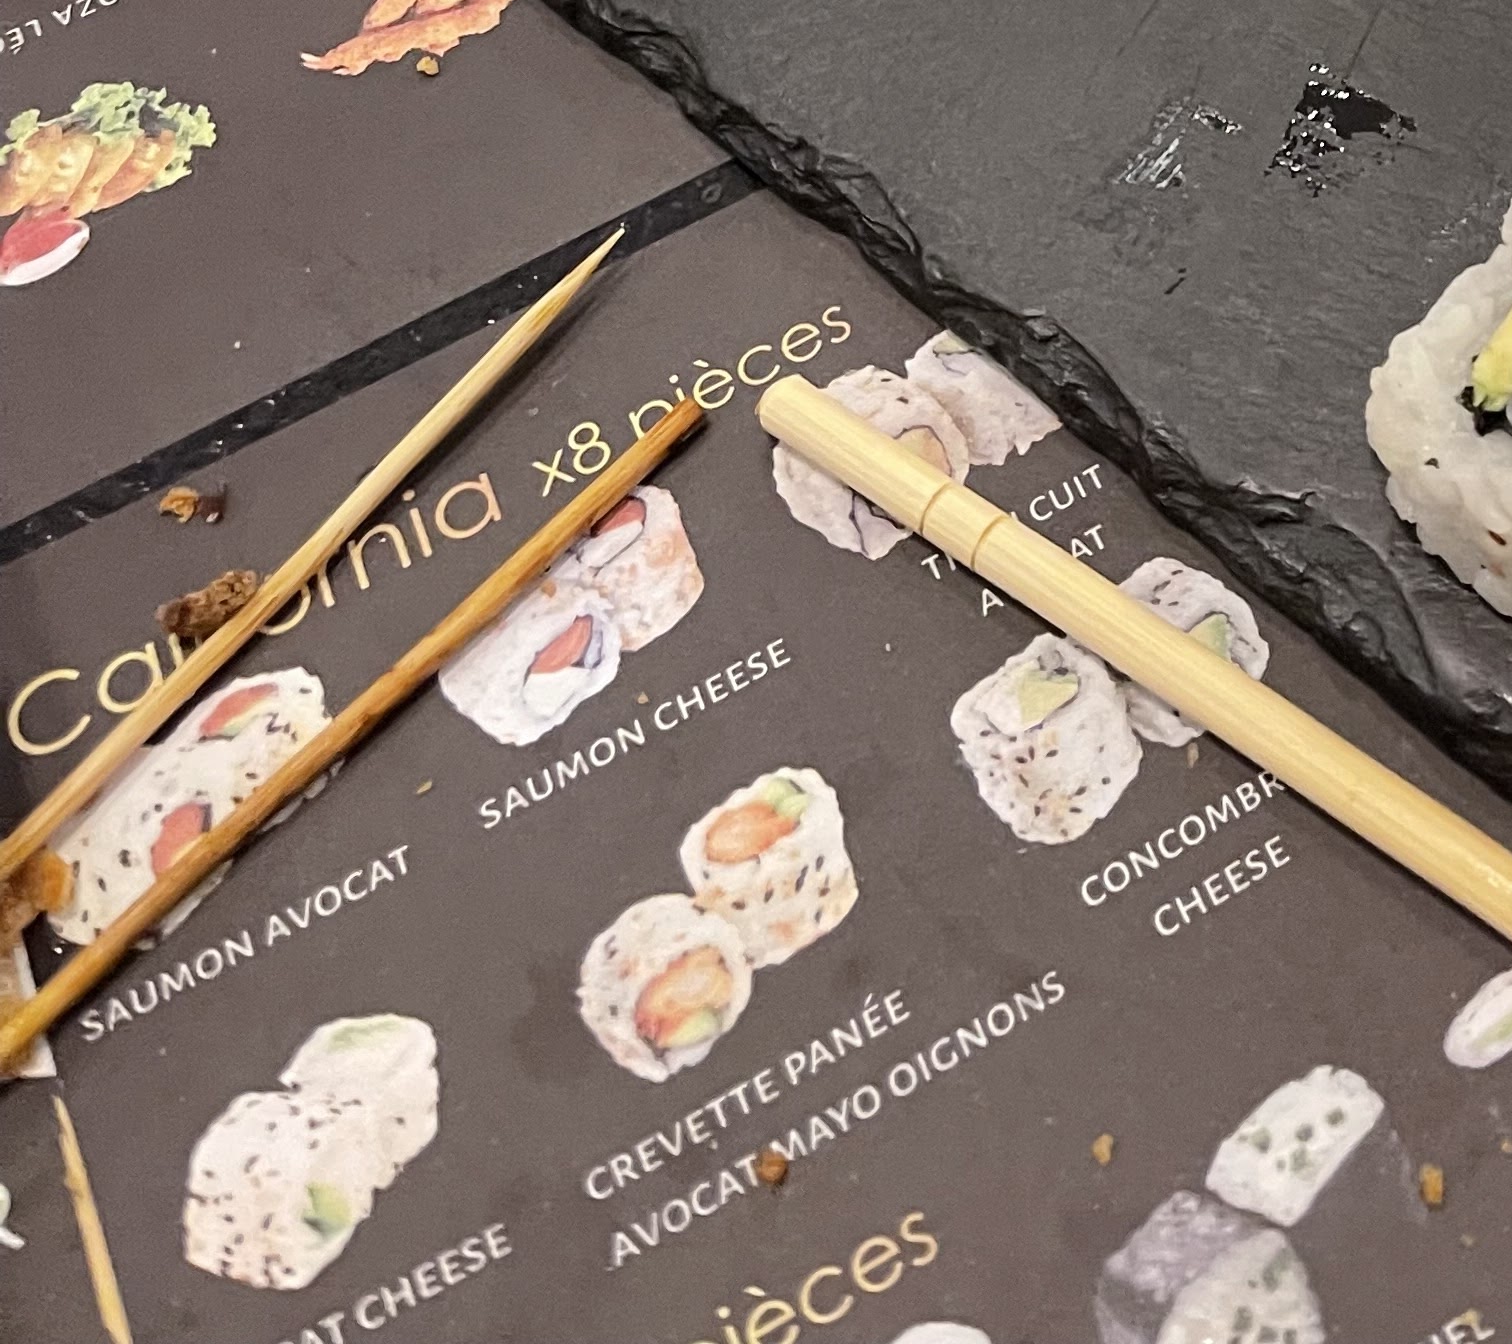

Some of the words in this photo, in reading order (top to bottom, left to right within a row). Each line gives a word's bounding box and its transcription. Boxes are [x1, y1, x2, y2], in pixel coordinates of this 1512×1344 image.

[531, 421, 612, 498] x8
[1029, 463, 1103, 522] CUIT
[479, 719, 647, 830] SAUMON
[653, 636, 794, 734] CHEESE
[1080, 769, 1286, 907] CONCOMBR
[1153, 834, 1292, 937] CHEESE
[79, 942, 256, 1044] SAUMON
[262, 844, 412, 951] AVOCAT
[584, 1067, 780, 1201] CREVETTE
[784, 989, 912, 1087] PANÉE
[611, 1153, 760, 1268] AVOCAT
[768, 1084, 882, 1162] MAYO
[887, 969, 1067, 1098] OIGNONS
[353, 1222, 513, 1330] CHEESE
